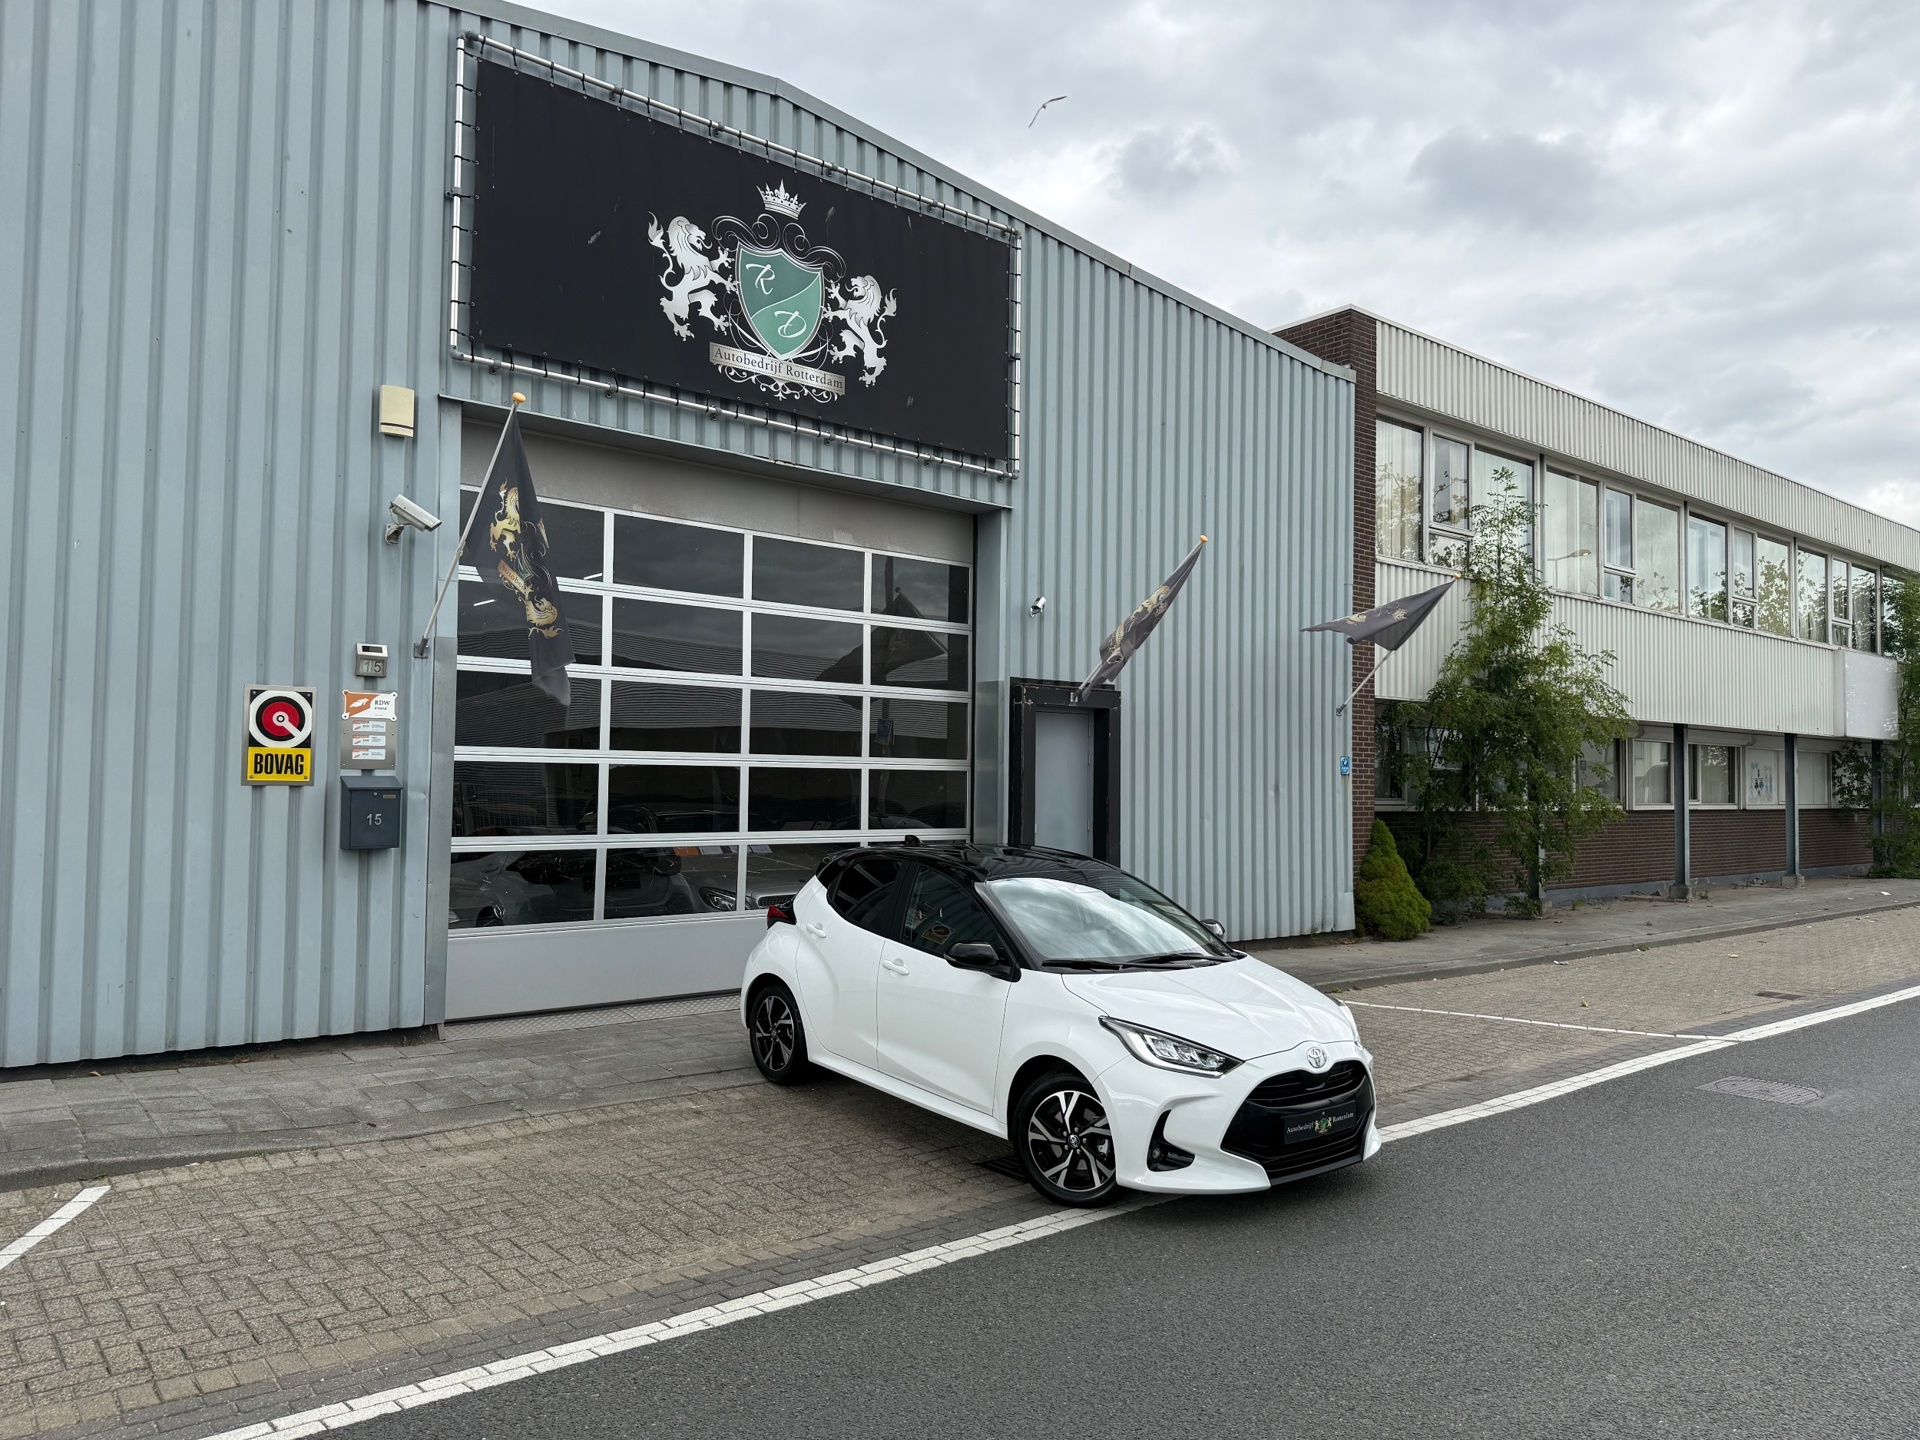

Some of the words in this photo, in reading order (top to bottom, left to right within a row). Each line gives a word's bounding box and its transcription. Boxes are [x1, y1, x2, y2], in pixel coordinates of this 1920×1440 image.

[745, 263, 776, 295] R
[774, 310, 807, 339] D
[714, 347, 784, 375] Autobedrijf
[786, 364, 843, 389] Rotterdam
[365, 660, 381, 673] 15
[254, 753, 304, 775] BOVAG
[366, 813, 382, 826] 15
